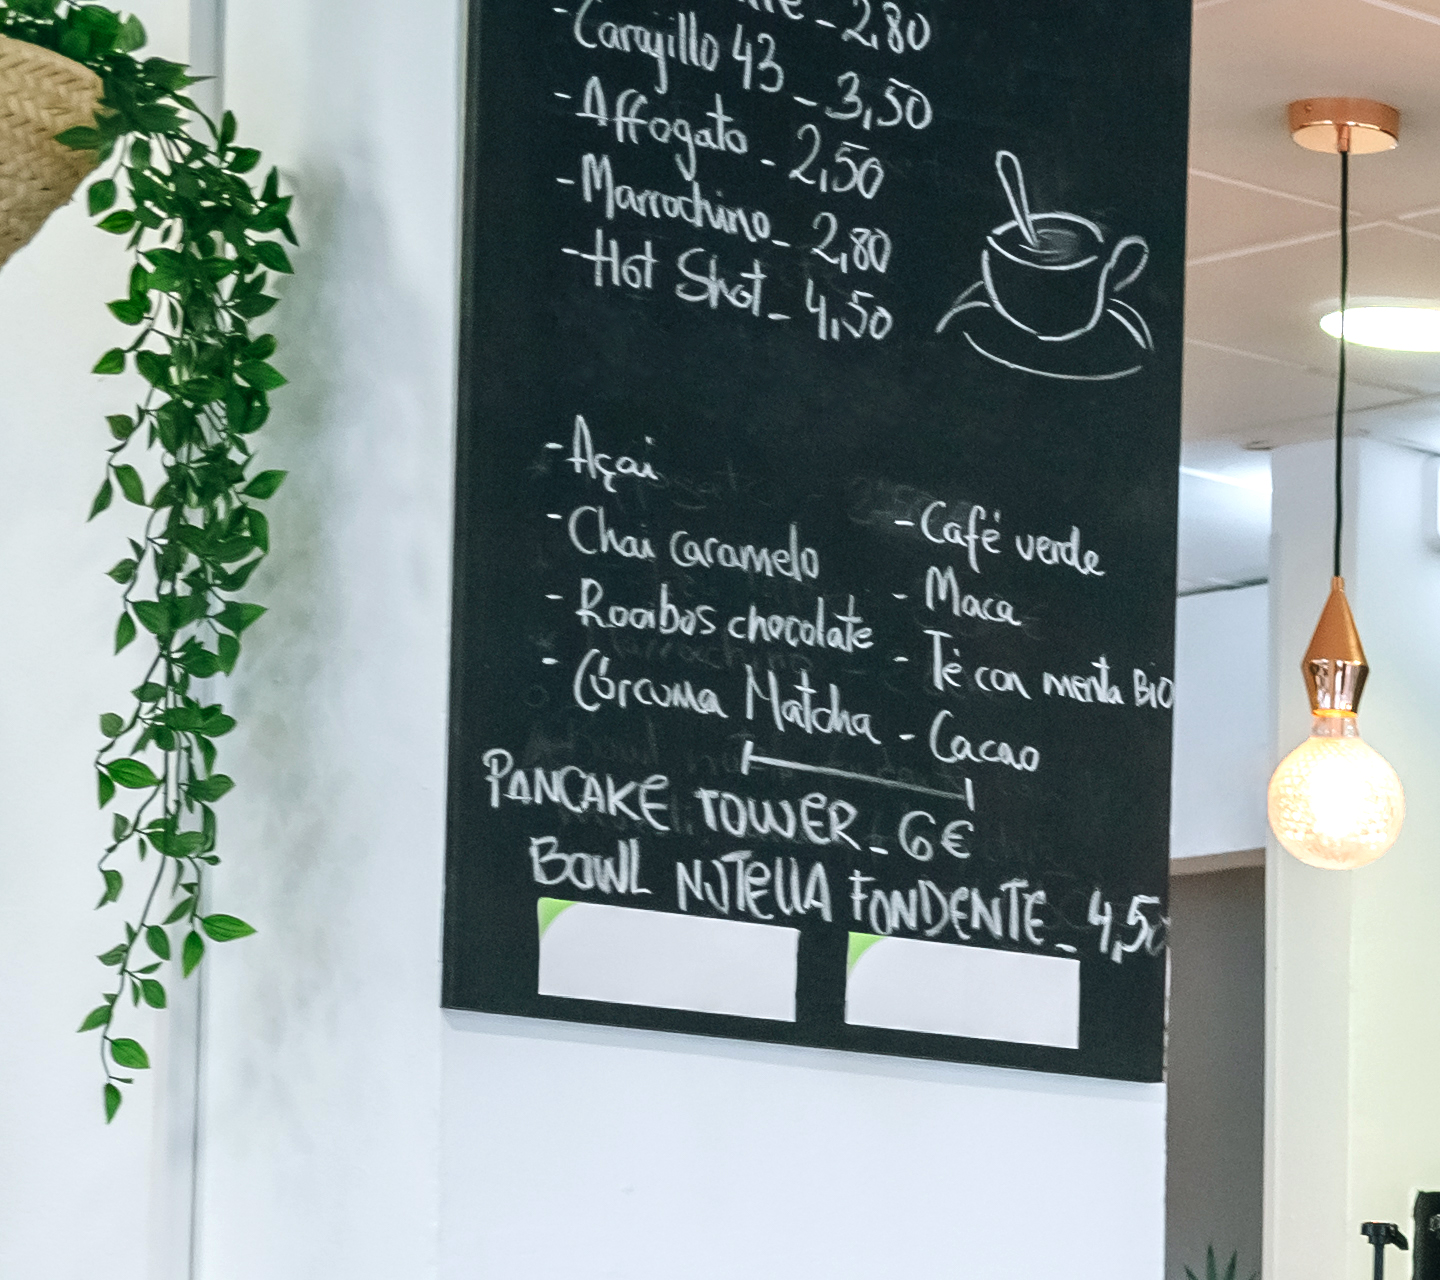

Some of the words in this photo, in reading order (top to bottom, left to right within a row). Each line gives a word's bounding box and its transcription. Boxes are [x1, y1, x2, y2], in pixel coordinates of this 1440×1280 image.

[731, 23, 785, 92] 43
[825, 70, 933, 130] 3,50
[575, 76, 749, 182] Affogato
[789, 123, 885, 199] 2,50
[811, 211, 892, 274] 2,80
[580, 228, 660, 290] Hot
[675, 247, 767, 317] Shot
[805, 278, 893, 342] 4,50
[568, 505, 656, 560] Chai
[1015, 525, 1106, 576] verde
[925, 565, 1022, 627] Maca
[743, 663, 881, 745] Matcha
[974, 666, 1033, 700] con
[1043, 652, 1125, 705] menta
[929, 709, 1040, 773] Cacao
[482, 748, 670, 833] PANCAKE
[695, 786, 862, 852] TOWER
[897, 810, 974, 861] 6€
[528, 835, 652, 897] BOWL
[675, 856, 832, 923] NUTELLA
[848, 869, 1045, 948] FONDENTE
